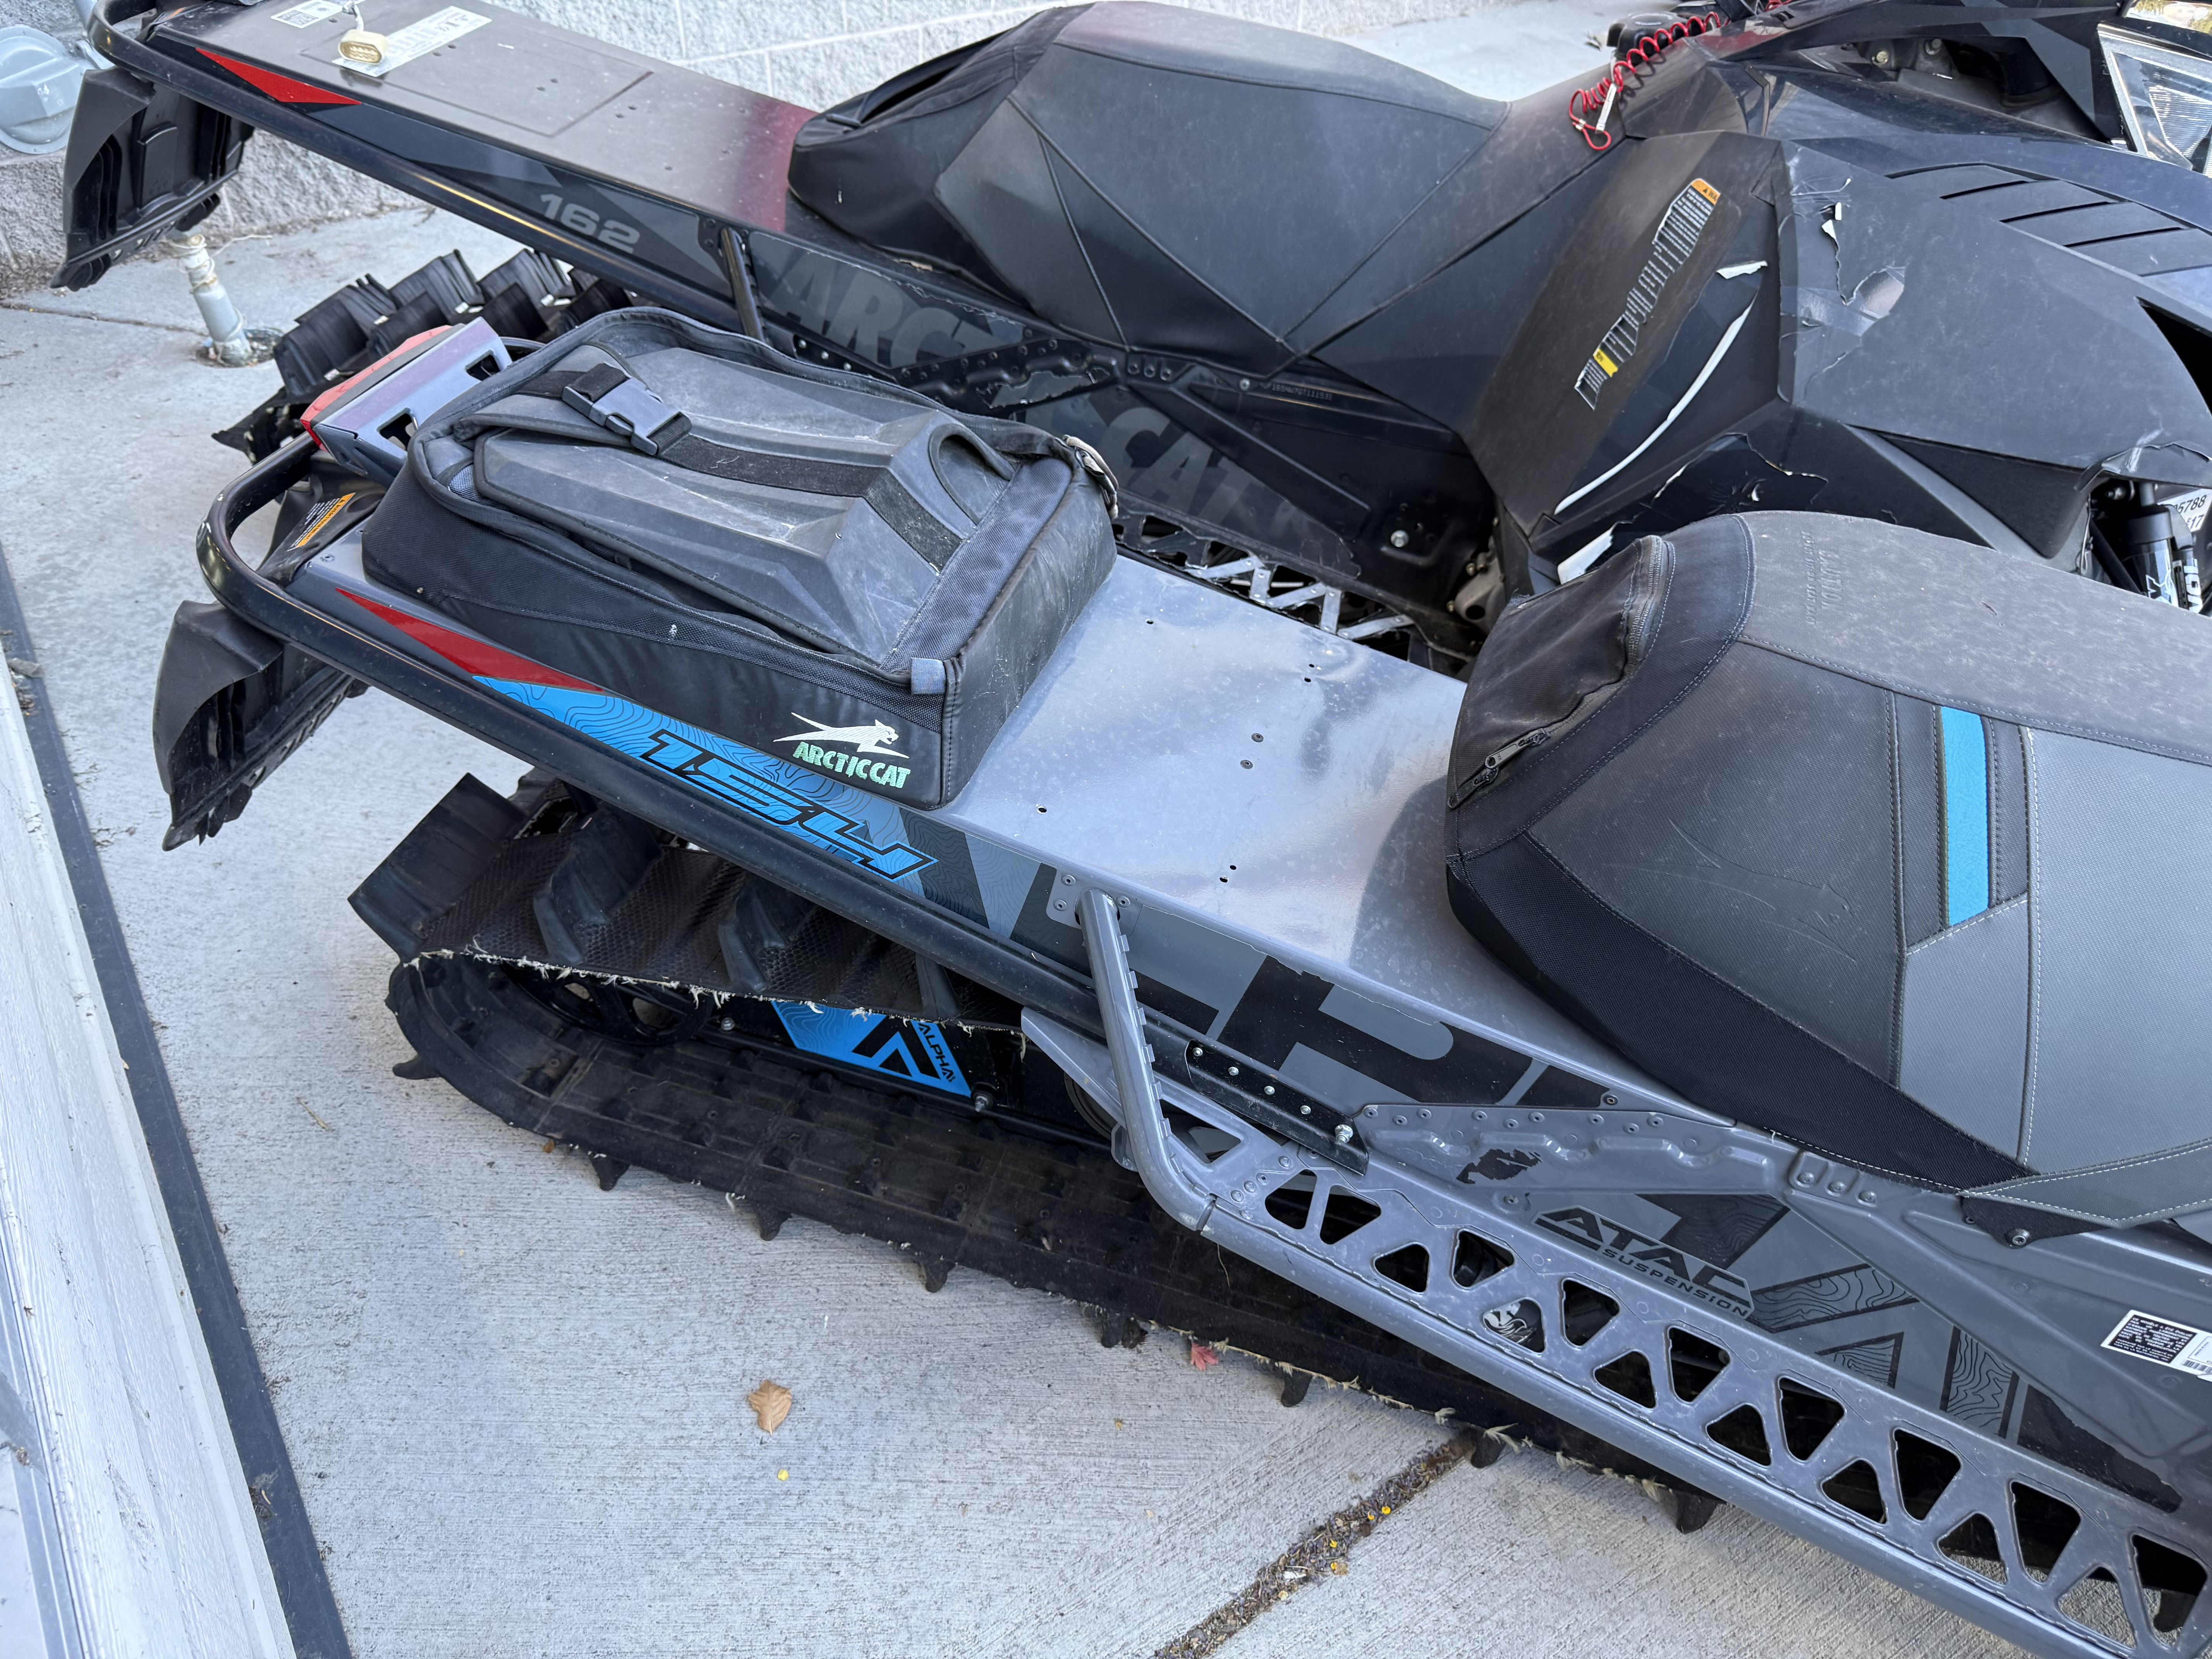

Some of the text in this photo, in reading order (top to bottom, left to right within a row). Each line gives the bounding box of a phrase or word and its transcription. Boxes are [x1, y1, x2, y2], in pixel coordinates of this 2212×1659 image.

[540, 193, 641, 254] 162
[2183, 557, 2203, 614] VOL
[639, 729, 939, 883] 154
[918, 1022, 954, 1080] ALPHA
[1535, 1206, 1753, 1309] ATAC
[1601, 1247, 1749, 1318] SUSPENSION
